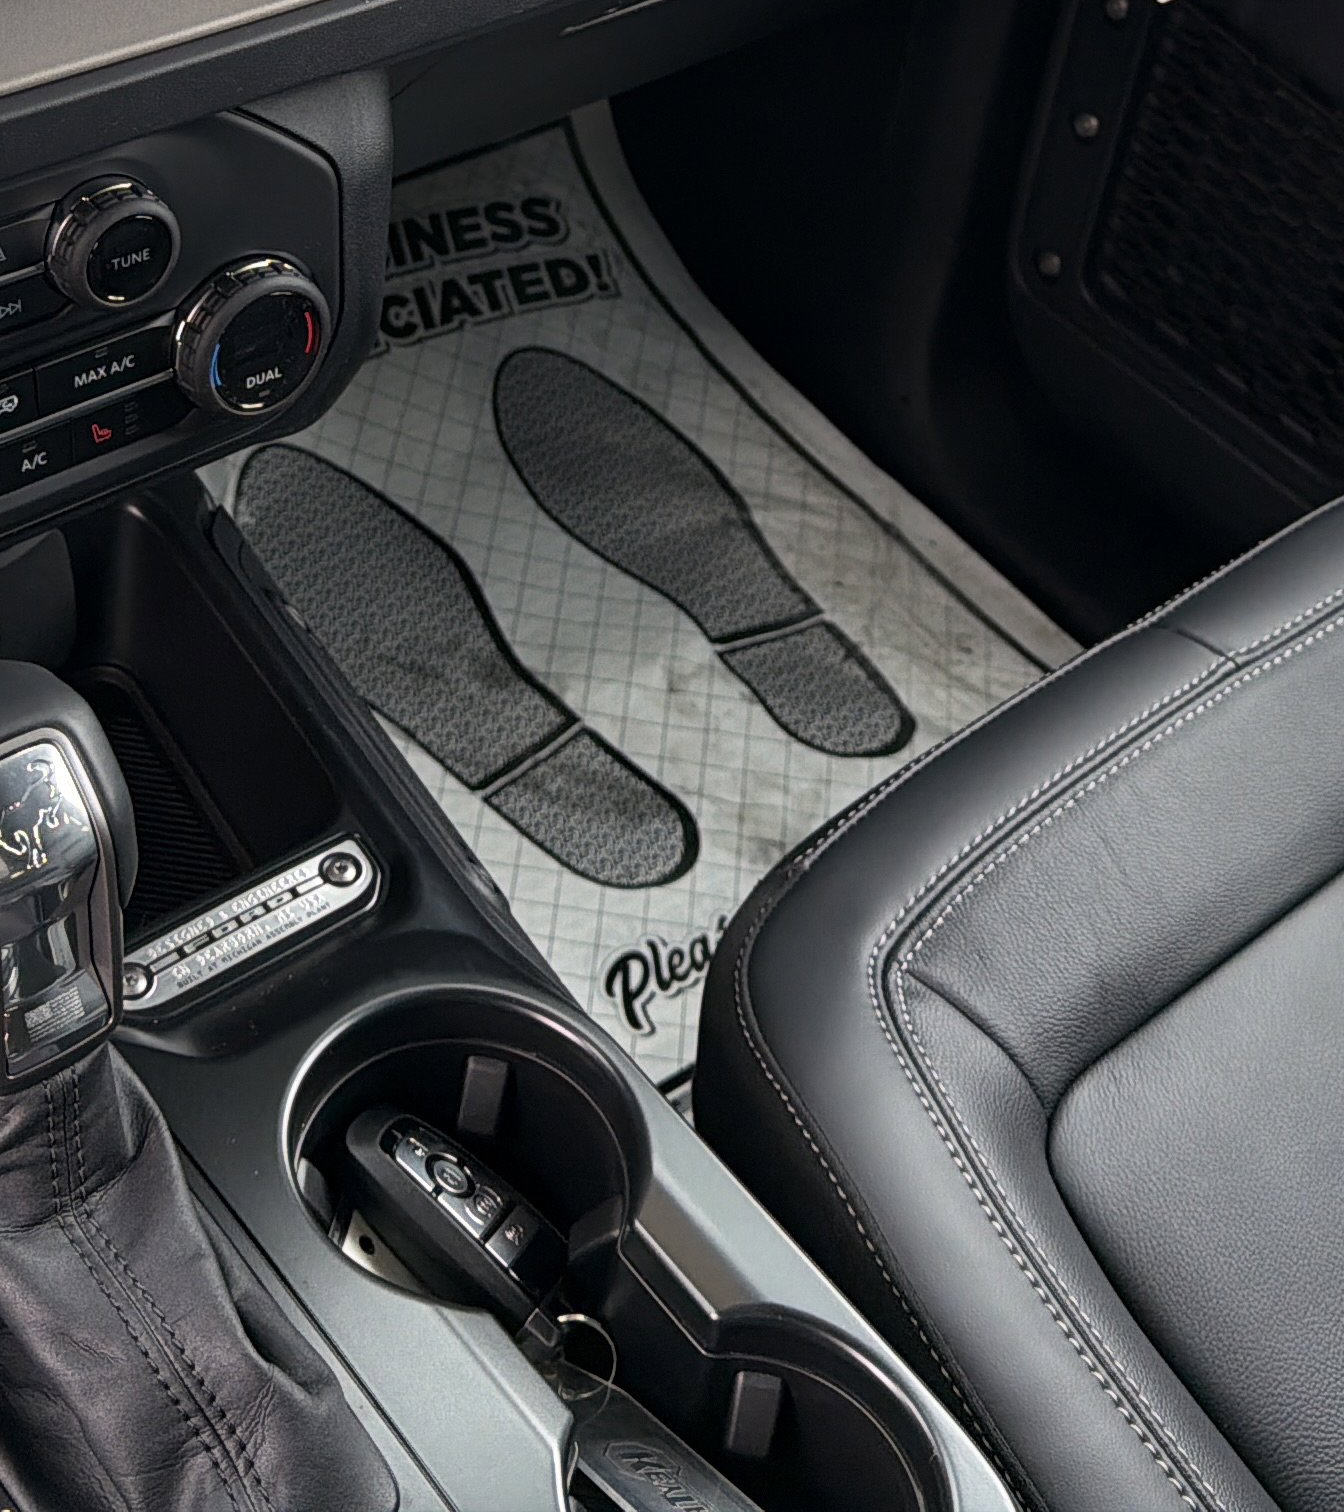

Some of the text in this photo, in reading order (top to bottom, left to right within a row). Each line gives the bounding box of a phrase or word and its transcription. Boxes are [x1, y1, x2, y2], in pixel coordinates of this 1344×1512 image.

[111, 248, 151, 271] TUNE
[74, 354, 136, 389] MAX A/C
[245, 366, 283, 390] DUAL
[21, 451, 48, 473] A/C
[298, 893, 327, 913] USA
[176, 970, 204, 989] BUILT
[220, 937, 263, 963] MICHIGAN
[265, 915, 305, 940] ASSEMBLY
[306, 901, 332, 919] PLANT
